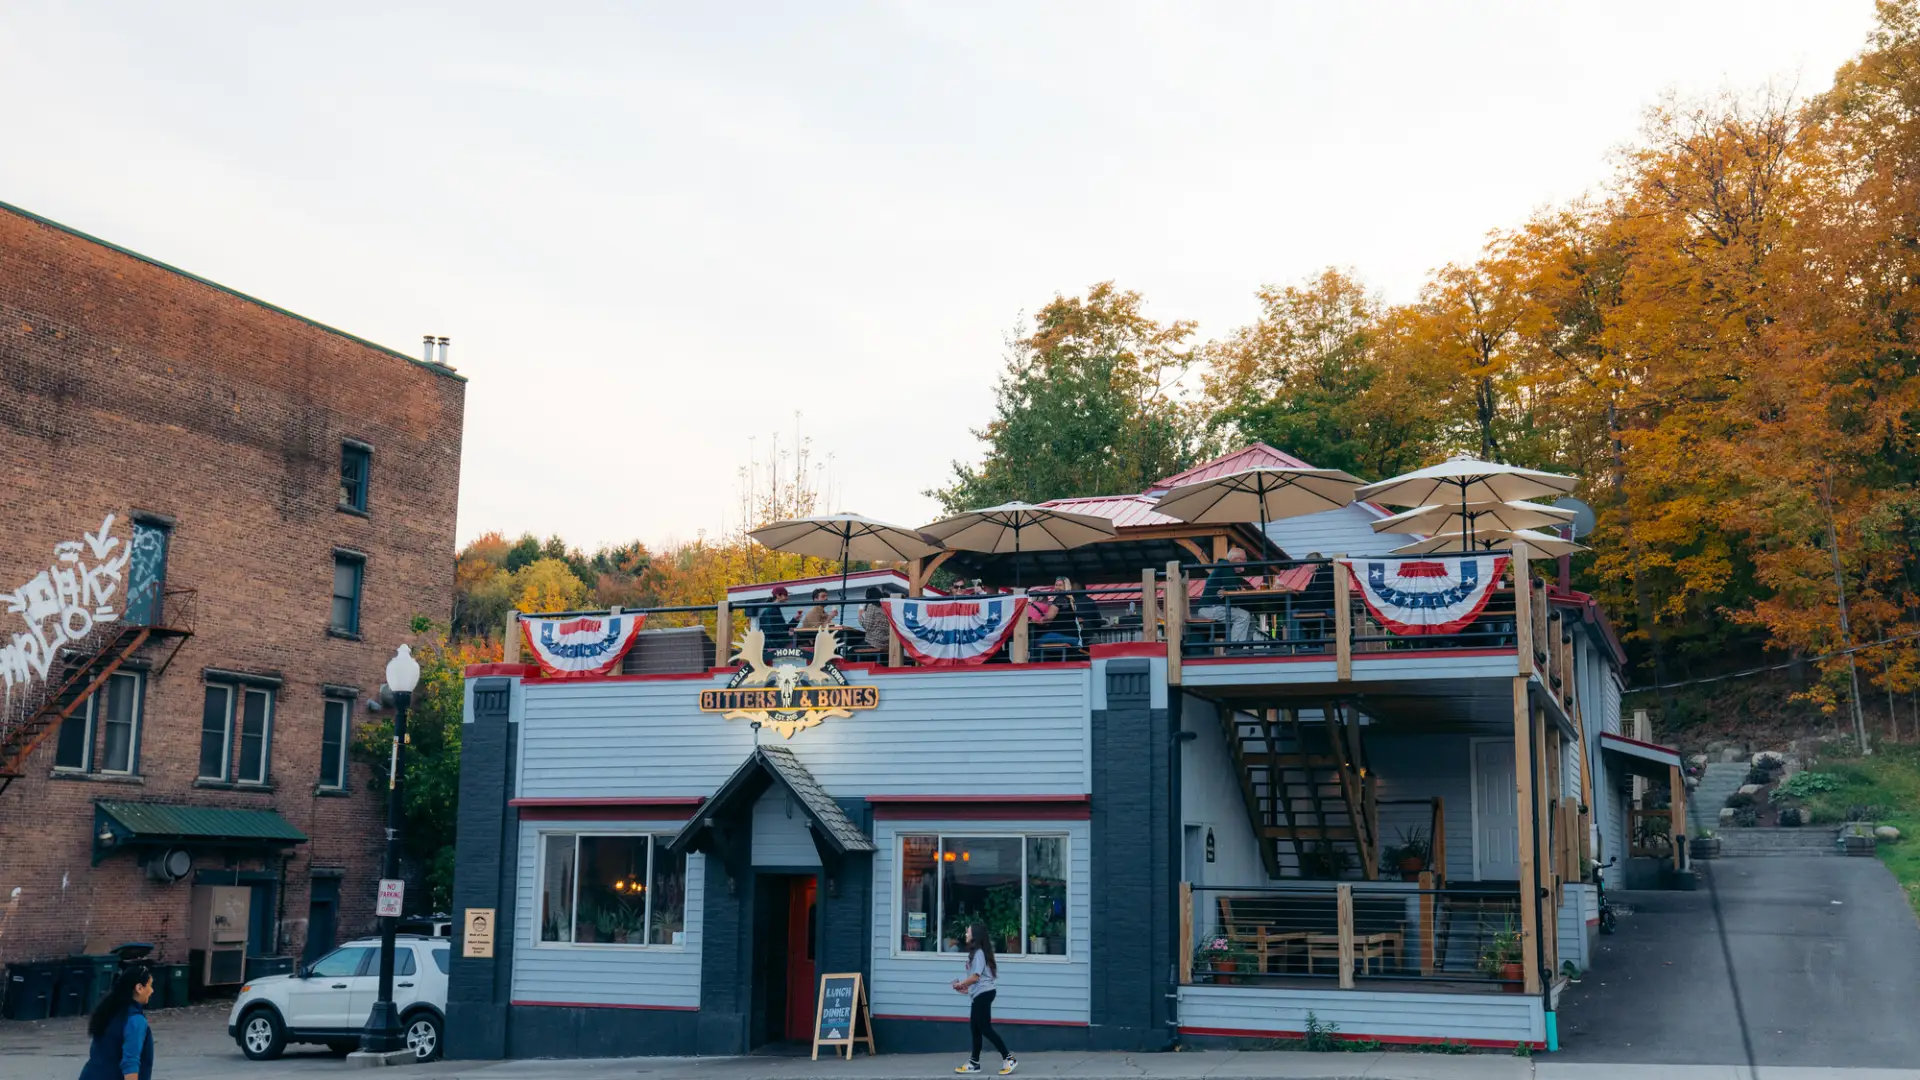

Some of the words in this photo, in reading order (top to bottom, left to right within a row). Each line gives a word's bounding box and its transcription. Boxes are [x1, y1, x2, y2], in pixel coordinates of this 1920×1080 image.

[732, 668, 748, 688] REAL
[776, 649, 801, 657] HOME
[828, 665, 845, 685] TOWN
[703, 691, 777, 709] BITTERS
[800, 691, 813, 708] &
[818, 688, 875, 708] BONES
[826, 987, 852, 998] LUNCH
[835, 998, 841, 1007] &
[823, 1007, 850, 1018] DINNER
